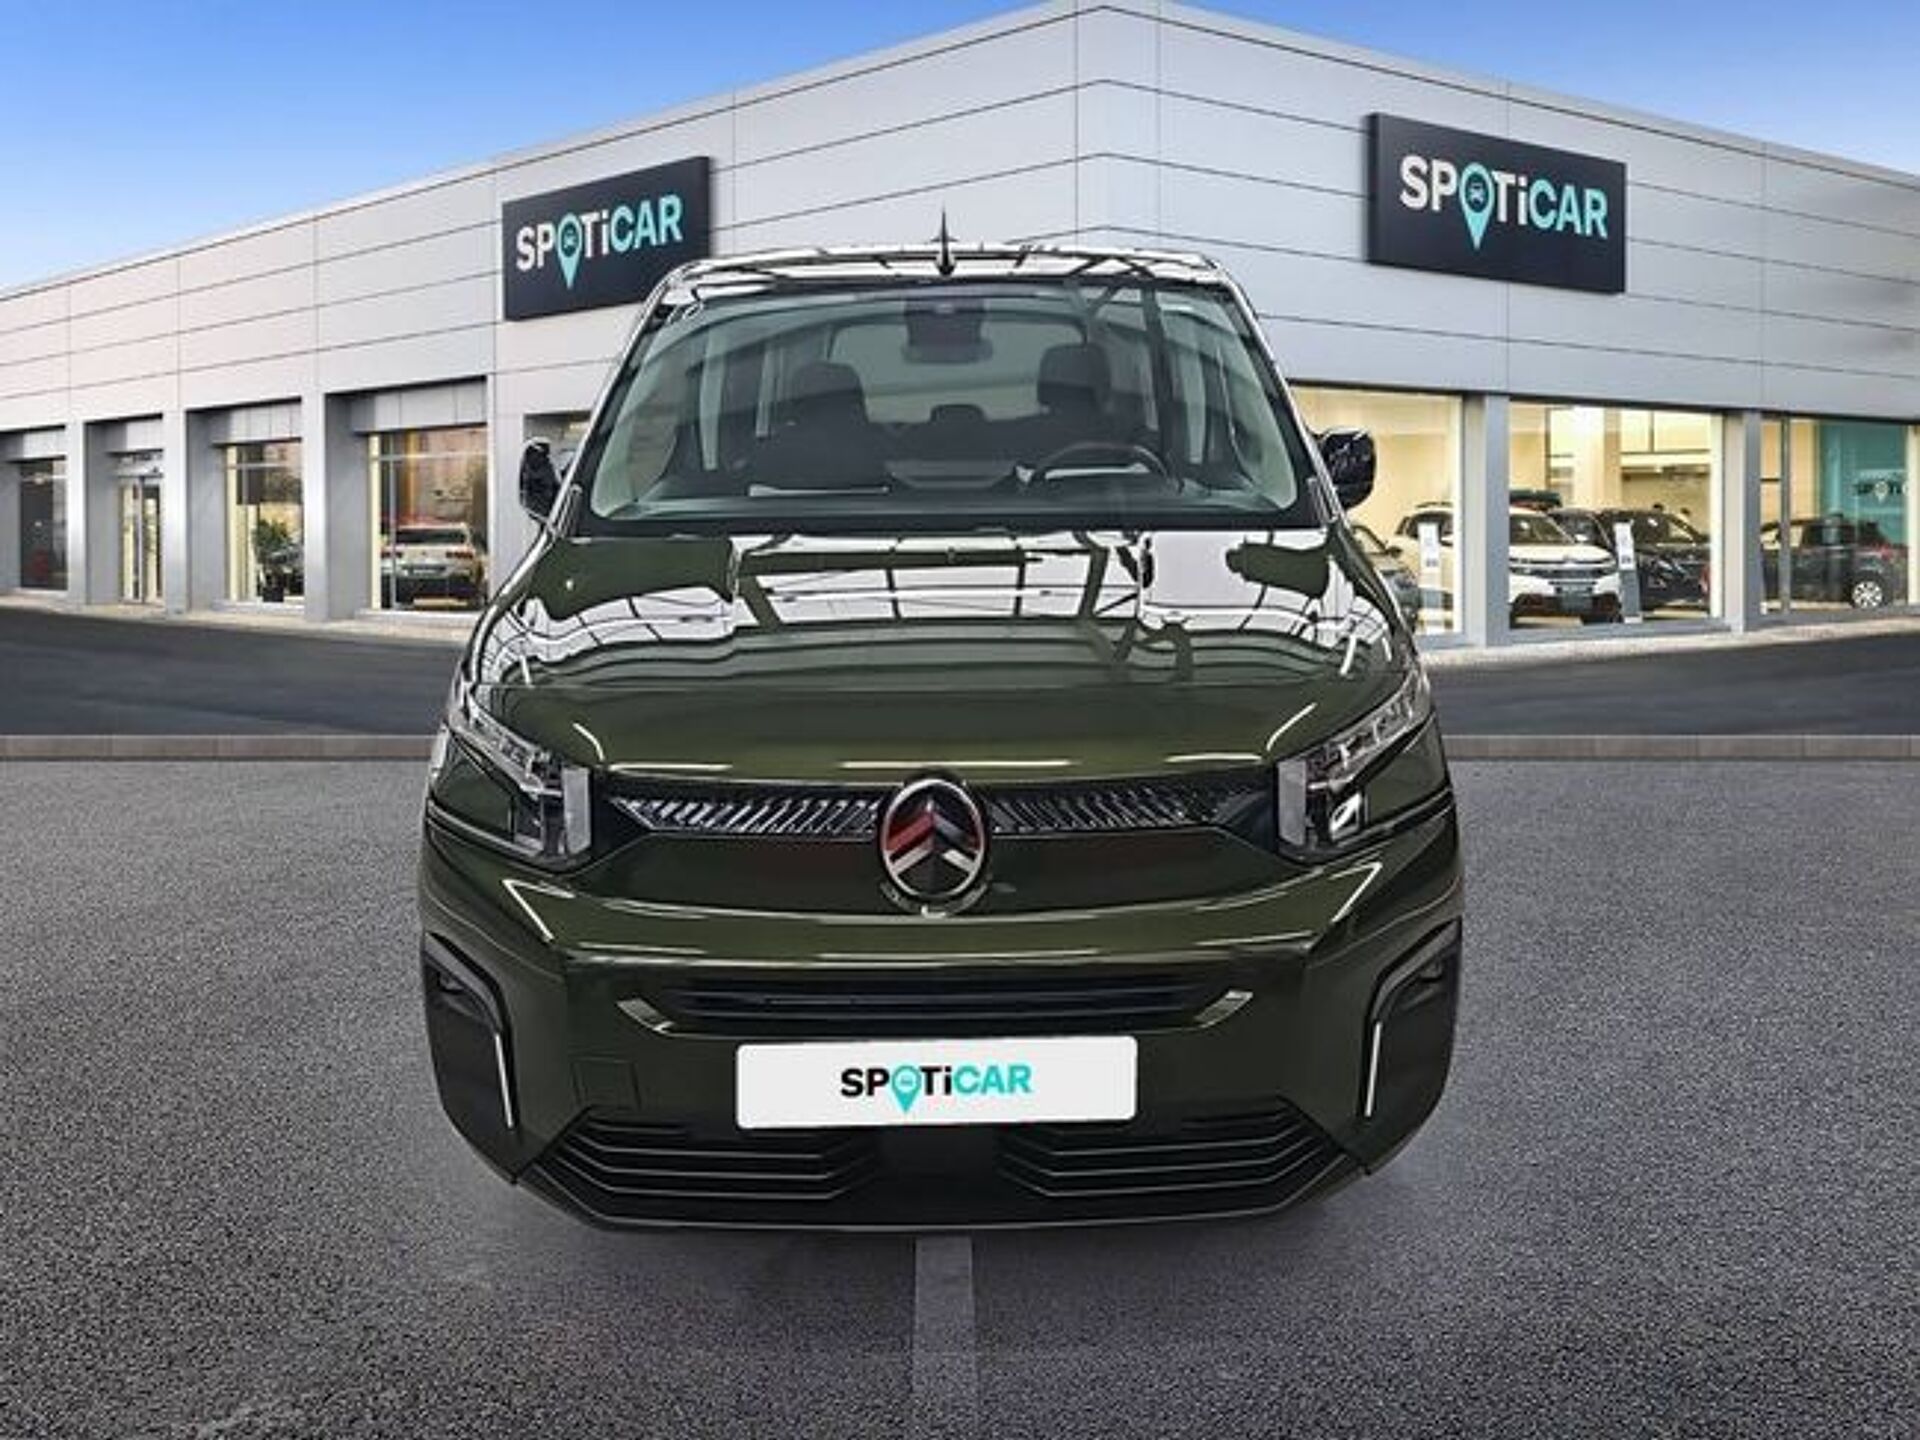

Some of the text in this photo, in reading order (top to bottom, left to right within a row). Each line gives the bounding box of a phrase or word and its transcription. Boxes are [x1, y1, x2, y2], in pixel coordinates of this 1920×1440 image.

[516, 194, 683, 290] SPOTiCAR
[1400, 155, 1608, 250] SPOTiCAR
[840, 1064, 1032, 1114] SPOTiCAR
